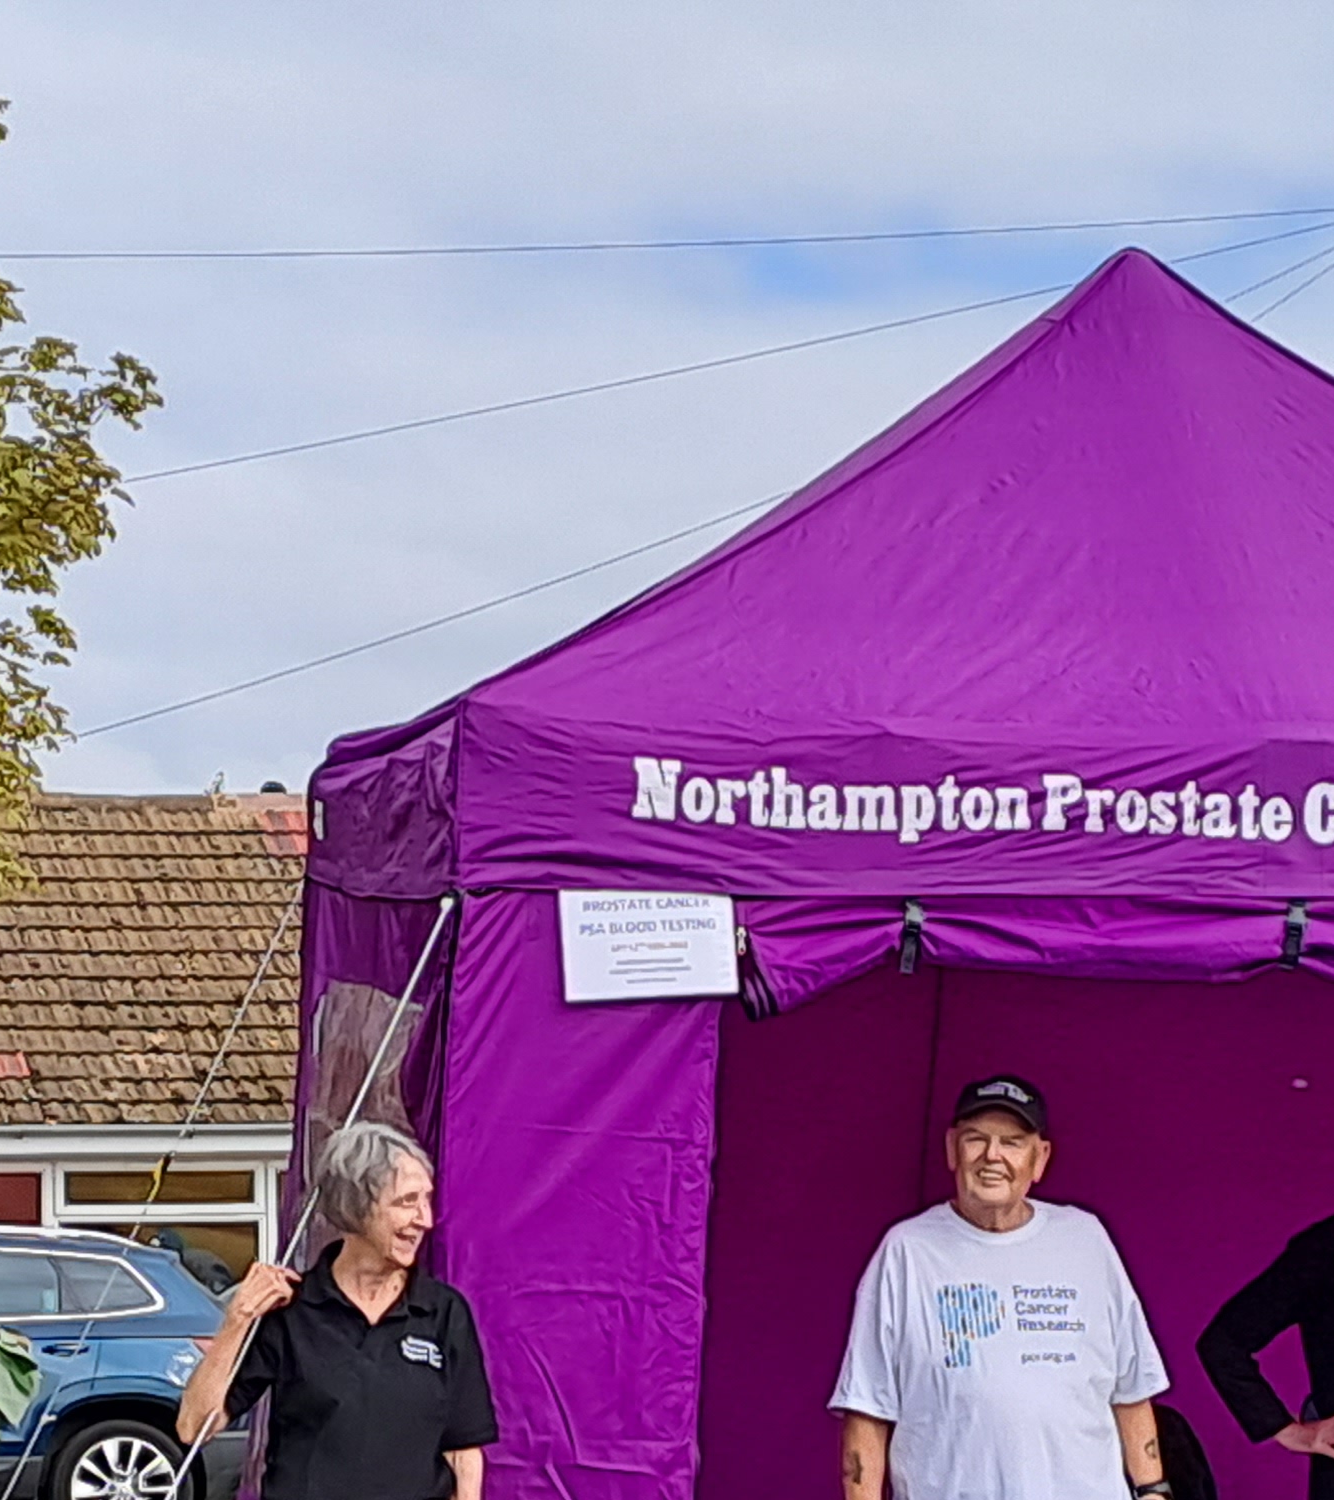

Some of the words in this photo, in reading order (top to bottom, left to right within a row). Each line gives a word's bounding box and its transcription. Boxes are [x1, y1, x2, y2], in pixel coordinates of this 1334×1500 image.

[632, 757, 1032, 843] Northampton
[1040, 774, 1294, 842] Prostate
[583, 899, 652, 912] PROSTATE
[656, 897, 711, 911] CANCER
[579, 923, 605, 936] PSA
[609, 921, 657, 935] BLOOD
[660, 918, 717, 932] TESTING
[1012, 1285, 1077, 1299] Prostate
[1015, 1301, 1068, 1315] Cancer
[1017, 1317, 1086, 1332] Research
